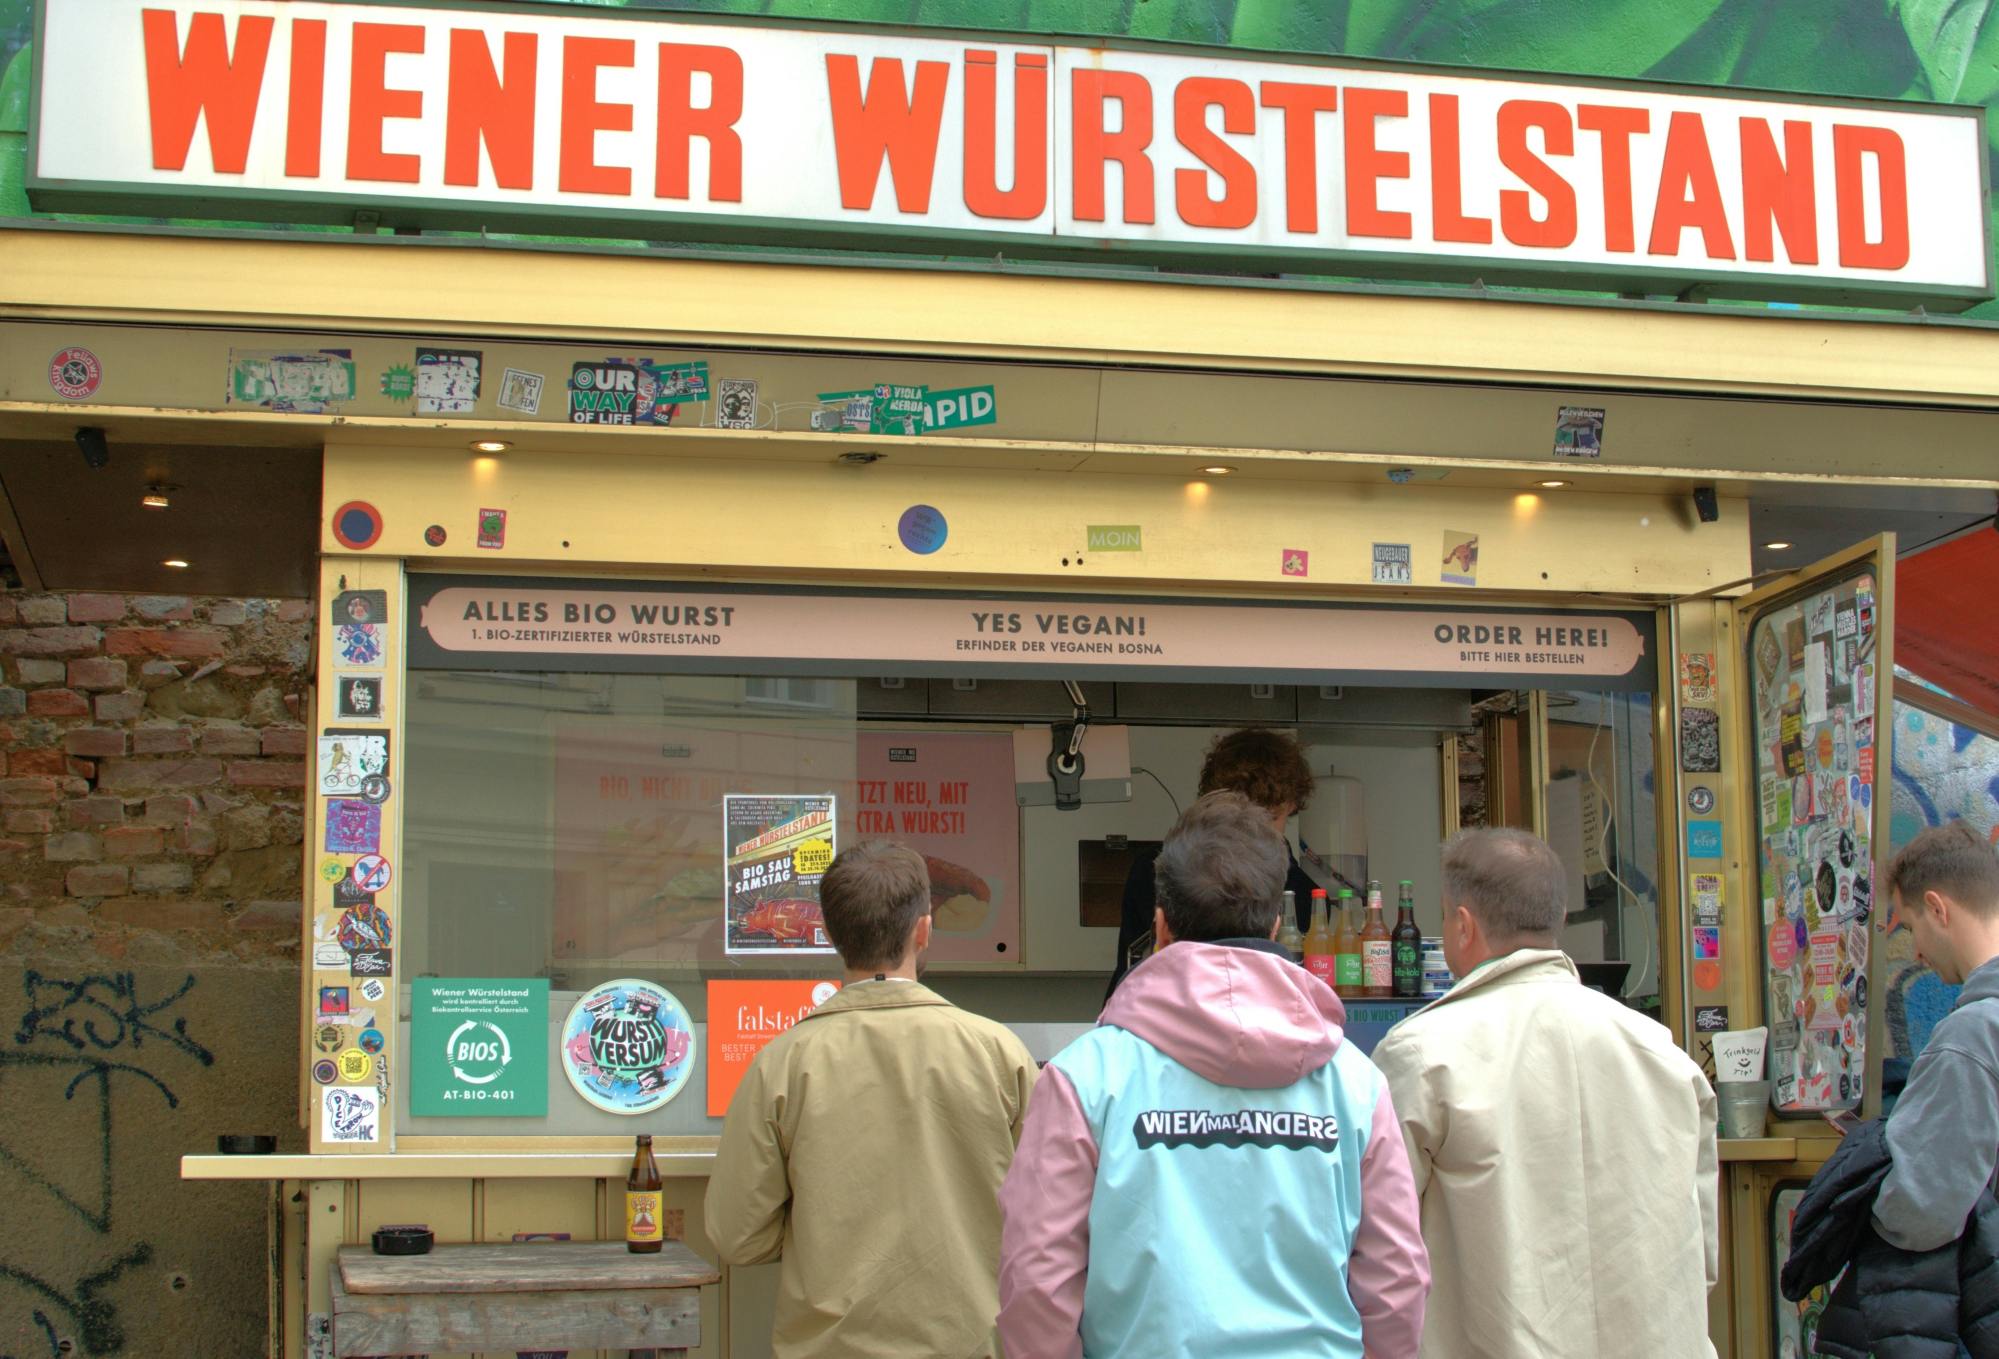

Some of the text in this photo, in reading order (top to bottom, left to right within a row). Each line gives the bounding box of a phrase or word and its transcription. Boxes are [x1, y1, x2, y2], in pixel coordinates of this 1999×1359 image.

[141, 8, 1911, 271] WIENER WÜRSTELSTAND
[574, 368, 636, 391] OUR
[573, 390, 636, 413] WAY
[923, 391, 993, 427] APID
[574, 412, 633, 425] OF LIFE
[1090, 531, 1140, 547] MOIN
[463, 600, 735, 627] ALLES BIO WURST
[971, 613, 1146, 636] YES VEGAN!
[471, 629, 721, 645] 1. BIO-ZERTIFIZIERTER WÜRSTELSTAND
[957, 640, 1163, 654] ERFINDER DER VEGANEN BOSNA
[1434, 624, 1609, 648] ORDER HERE!
[1460, 651, 1585, 664] BITTE HIER BESTELLEN
[893, 781, 932, 809] NEU,
[939, 782, 969, 804] MIT
[901, 811, 965, 834] WURST!
[742, 864, 764, 880] BIO
[768, 857, 791, 873] SAU
[735, 870, 791, 894] SAMSTAG
[432, 988, 529, 997] Wiener Würstelstand
[494, 1005, 529, 1013] Österreich
[457, 1041, 498, 1062] BIOS
[590, 1037, 667, 1066] VERSUM
[721, 1043, 756, 1053] BESTER
[724, 1053, 747, 1062] BEST
[443, 1090, 515, 1100] AT-BIO-401
[334, 1095, 342, 1128] DICE
[359, 1124, 374, 1140] HC
